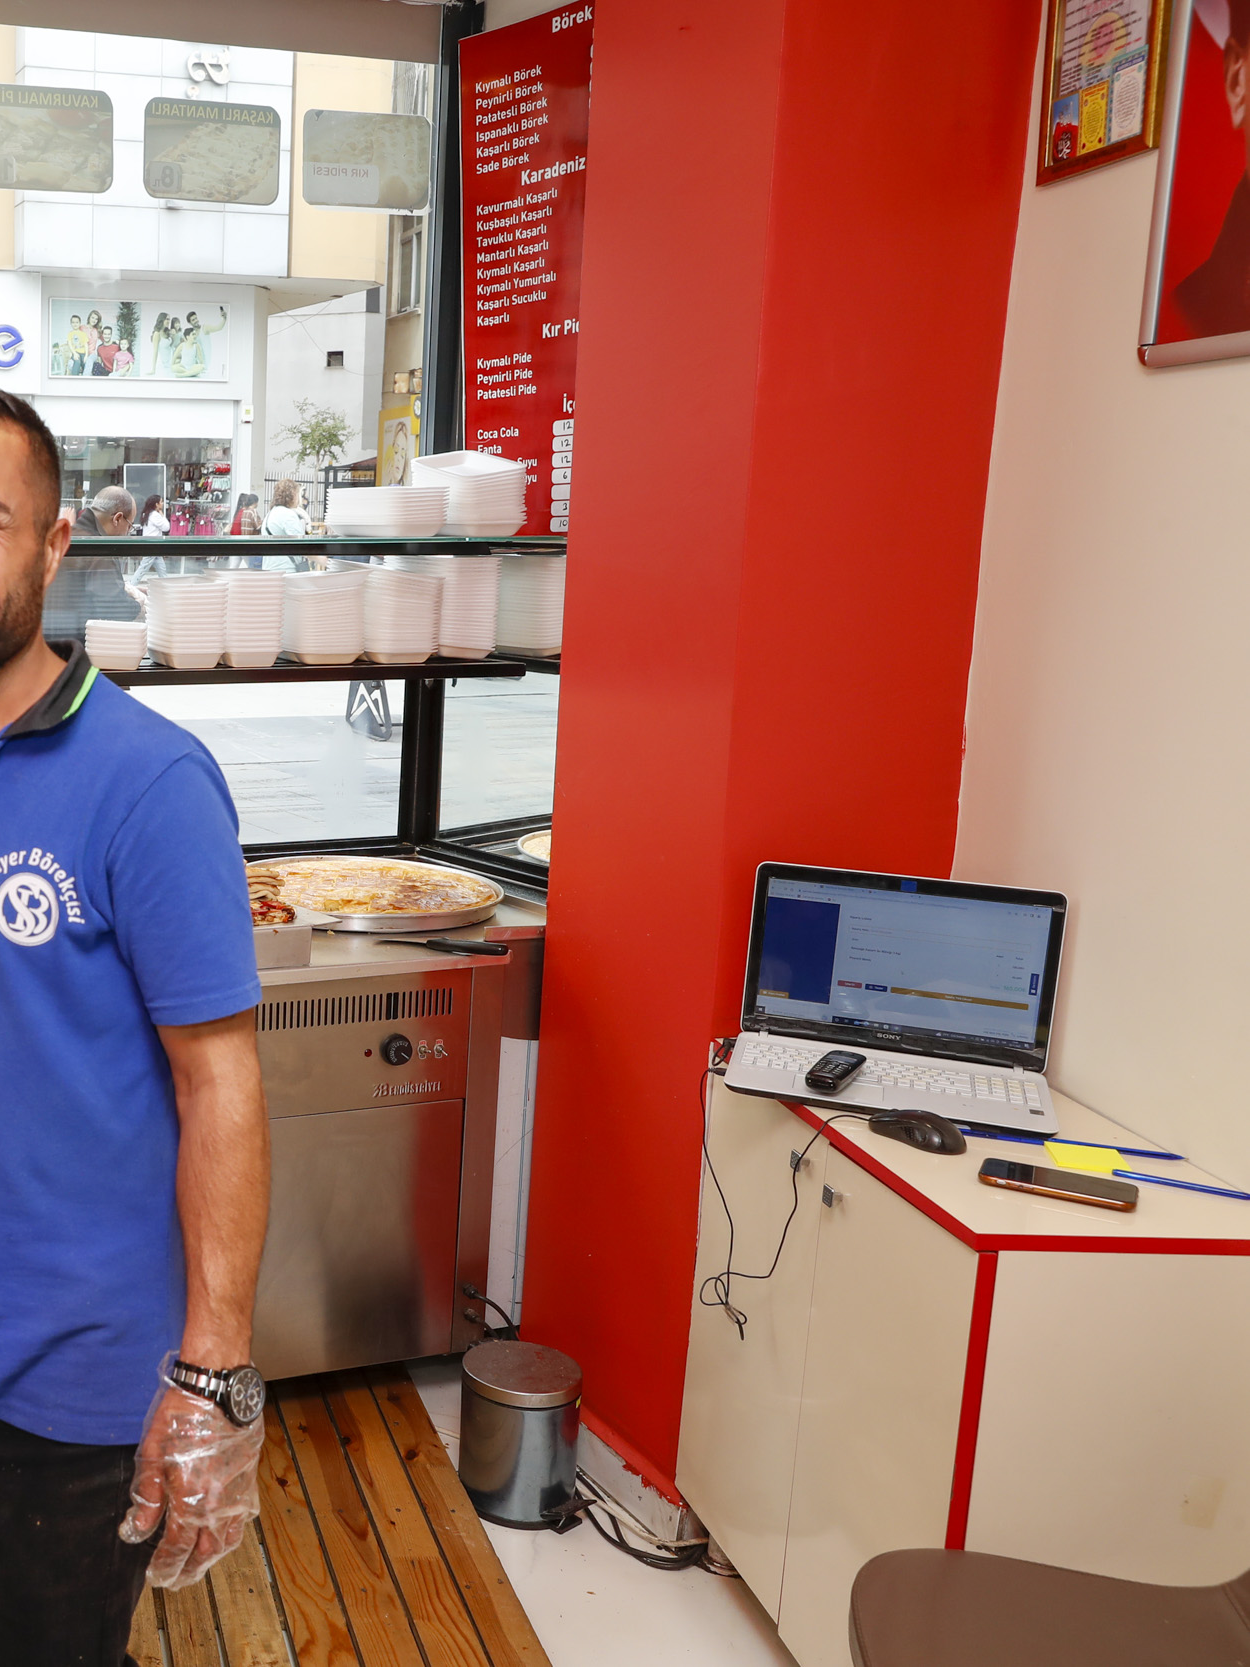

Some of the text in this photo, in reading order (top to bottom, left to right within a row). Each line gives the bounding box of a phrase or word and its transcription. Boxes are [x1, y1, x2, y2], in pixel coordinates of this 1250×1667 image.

[551, 5, 593, 33] Börek
[475, 64, 542, 94] Kıymalı Börek
[475, 81, 543, 110] Peynirli Börek
[475, 97, 548, 126] Patatesli Börek
[475, 113, 549, 143] Ispanaklı Börek
[476, 132, 540, 158] Kaşarlı Börek
[476, 152, 530, 175] Sade Börek
[521, 155, 586, 186] Karadeniz
[476, 187, 558, 216] Kavurmalı Kaşarlı
[521, 205, 553, 222] Kaşarlı
[476, 223, 547, 248] Tavuklu Kaşarlı
[476, 239, 549, 264] Mantarlı Kaşarlı
[476, 256, 545, 280] Kıymalı Kaşarlı
[476, 271, 557, 296] Kıymalı Yumurtalı
[476, 290, 547, 312] Kaşarlı Sucuklu
[476, 312, 510, 327] Kaşarlı
[542, 322, 561, 339] Kır
[477, 352, 532, 371] Kıymalı Pide
[477, 368, 533, 386] Peynirli Pide
[477, 384, 537, 400] Patatesli Pide
[477, 426, 519, 440] Coca Cola
[563, 421, 573, 431] 12
[477, 444, 502, 455] Fanta
[561, 439, 571, 447] 12
[561, 455, 571, 464] 12
[563, 471, 568, 480] 6
[562, 503, 568, 511] 3
[876, 1032, 901, 1041] SONY
